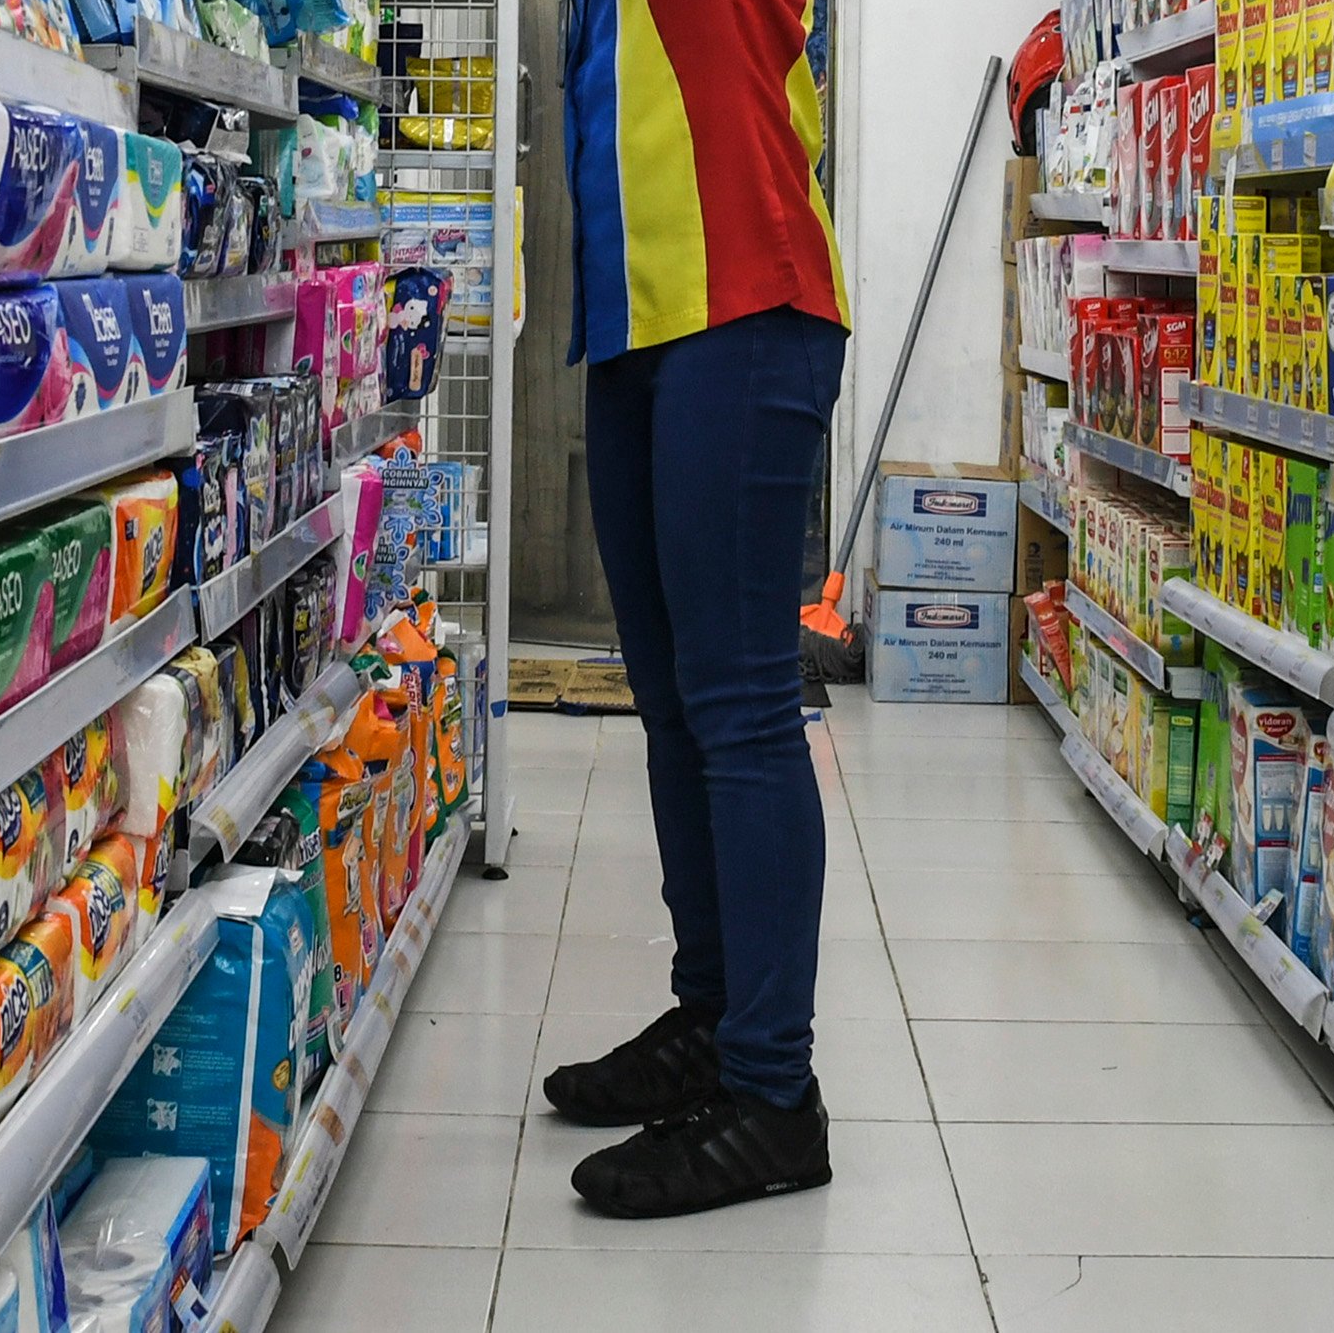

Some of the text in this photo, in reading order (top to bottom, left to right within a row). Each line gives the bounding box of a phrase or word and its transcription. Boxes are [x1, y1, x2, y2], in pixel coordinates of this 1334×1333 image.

[1142, 91, 1159, 133] SGM
[1189, 81, 1210, 132] SGM
[1164, 106, 1179, 142] SGM
[11, 125, 49, 173] PASEO
[81, 293, 122, 344] Tessa
[142, 289, 173, 336] Tessa
[1164, 320, 1187, 335] SGM
[384, 470, 418, 479] COBAIN
[926, 496, 973, 509] Indomaret
[889, 522, 1008, 538] Air Minum Dalam Kemasan
[934, 538, 964, 547] 240 ml
[142, 526, 164, 576] nice
[920, 609, 966, 622] Indomaret
[883, 638, 1002, 649] Air Minum Dalam Kemasan
[928, 651, 958, 660] 240 ml
[1257, 714, 1295, 732] vidoran
[88, 883, 112, 942] nice
[0, 974, 31, 1046] nice
